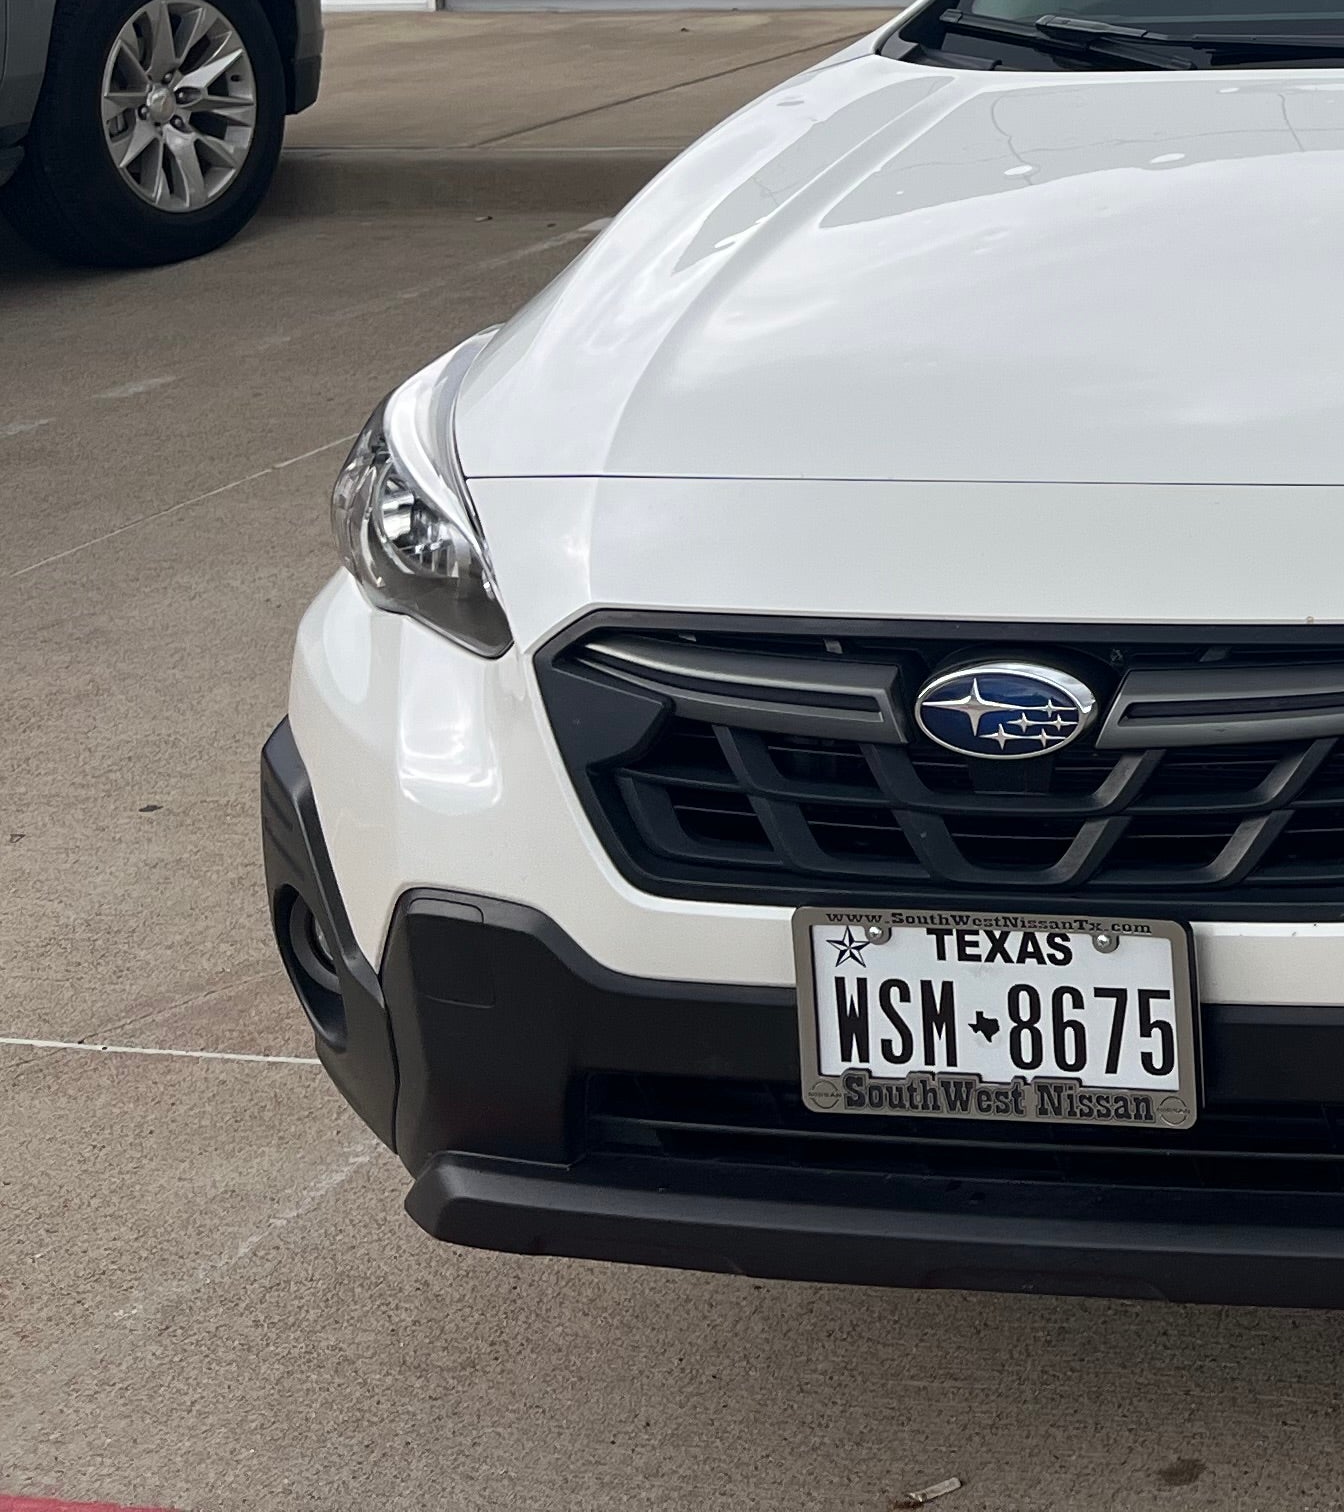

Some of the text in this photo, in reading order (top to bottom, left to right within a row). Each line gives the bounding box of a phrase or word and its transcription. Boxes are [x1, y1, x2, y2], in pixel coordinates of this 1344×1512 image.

[826, 912, 1152, 934] www.SouthWestNissanTx.com
[926, 928, 1074, 967] TEXAS
[834, 976, 1175, 1076] WSM 8675
[844, 1074, 1155, 1121] SouthWest Nissan
